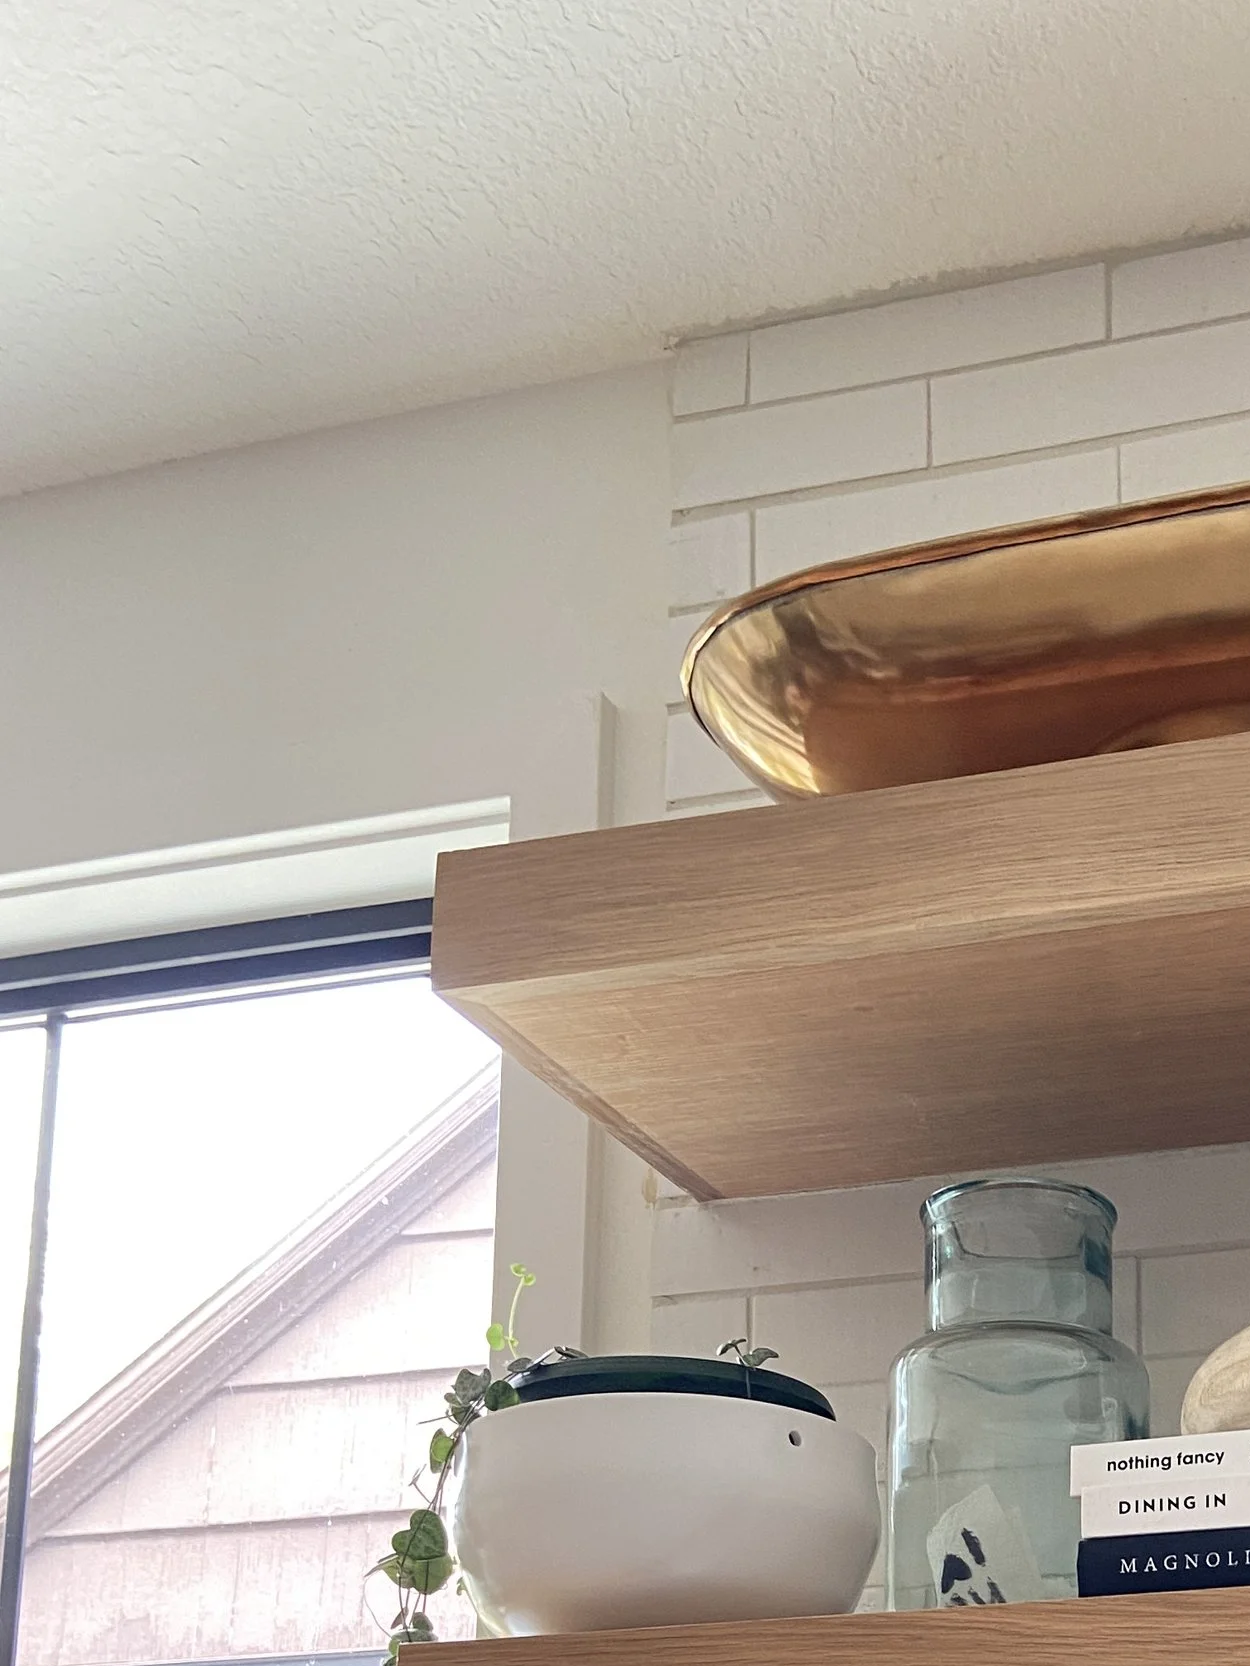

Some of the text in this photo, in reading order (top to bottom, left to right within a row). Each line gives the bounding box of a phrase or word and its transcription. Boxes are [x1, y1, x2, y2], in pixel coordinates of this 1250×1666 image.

[1107, 1455, 1172, 1471] nothing
[1177, 1452, 1225, 1465] fancy
[1119, 1496, 1196, 1514] DINING
[1206, 1493, 1226, 1508] IN
